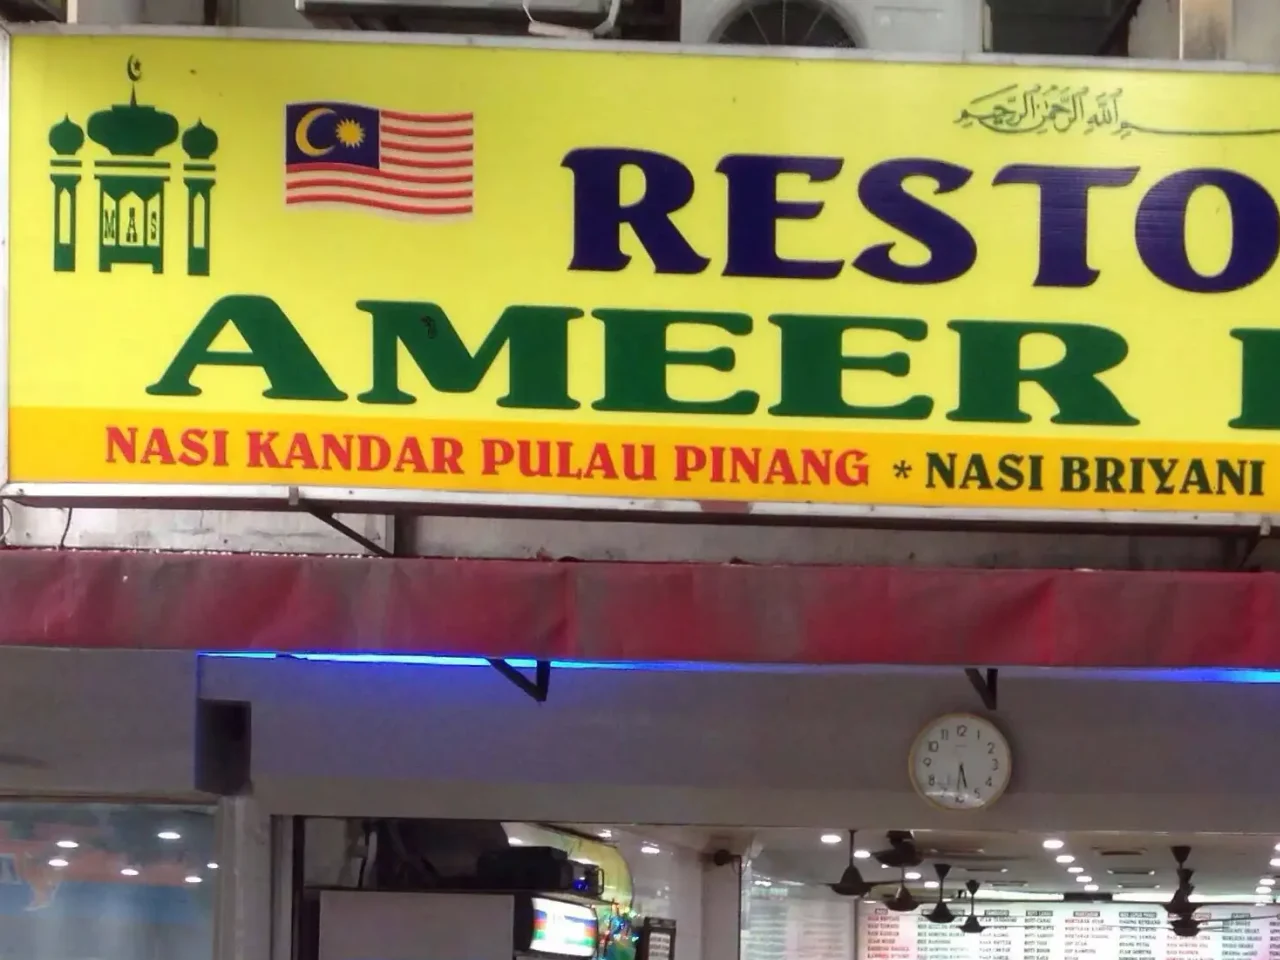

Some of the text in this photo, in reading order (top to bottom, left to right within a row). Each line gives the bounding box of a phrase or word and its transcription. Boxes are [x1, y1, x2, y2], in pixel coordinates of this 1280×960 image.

[145, 294, 1141, 427] AMEER
[106, 426, 229, 467] NASI
[246, 430, 465, 476] KANDAR
[481, 438, 658, 483] PULAU
[673, 444, 870, 487] PINANG
[925, 451, 1045, 492] NASI
[1059, 456, 1266, 497] BRIYANI
